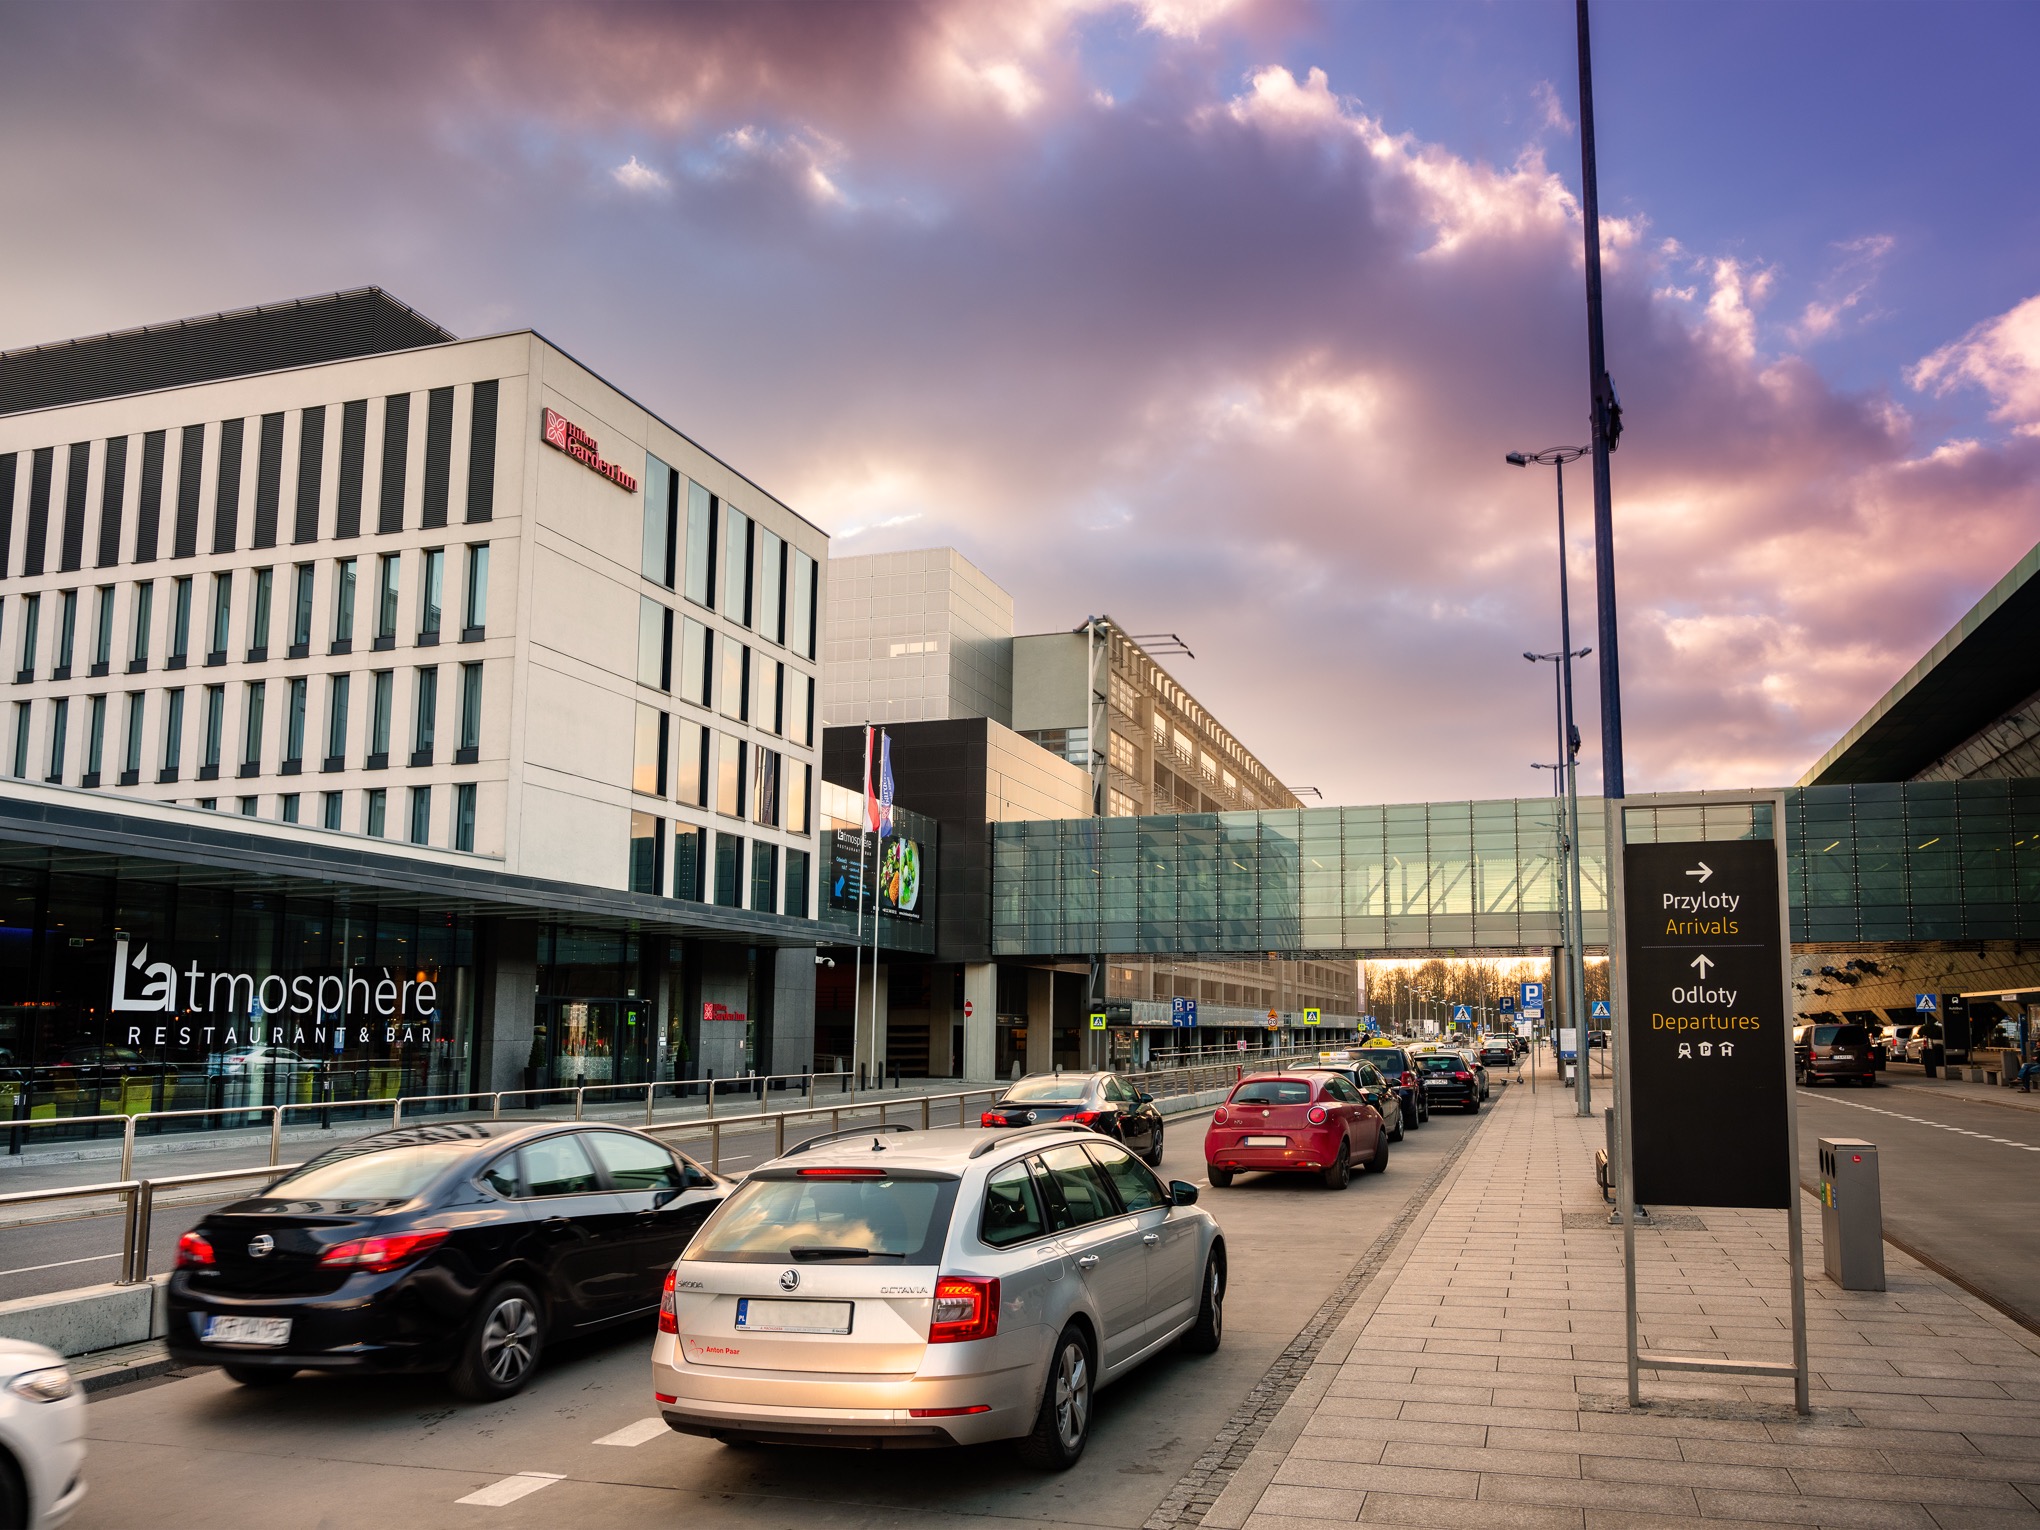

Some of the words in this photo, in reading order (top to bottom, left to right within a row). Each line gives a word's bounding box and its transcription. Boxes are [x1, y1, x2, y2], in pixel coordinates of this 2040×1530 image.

[568, 422, 598, 450] Hilton
[567, 436, 615, 479] Garden
[616, 464, 638, 491] Inn
[1663, 891, 1740, 913] Przyloty
[1665, 916, 1739, 935] Arrivals
[1526, 985, 1539, 1001] P
[1671, 985, 1737, 1008] Odloty
[1187, 1001, 1194, 1011] P
[1502, 998, 1512, 1009] P
[1652, 1013, 1760, 1034] Departures
[128, 1026, 346, 1045] RESTAURANT
[359, 1027, 370, 1043] &
[386, 1027, 431, 1043] BAR
[706, 1346, 724, 1354] Anton
[725, 1347, 740, 1355] Paar
